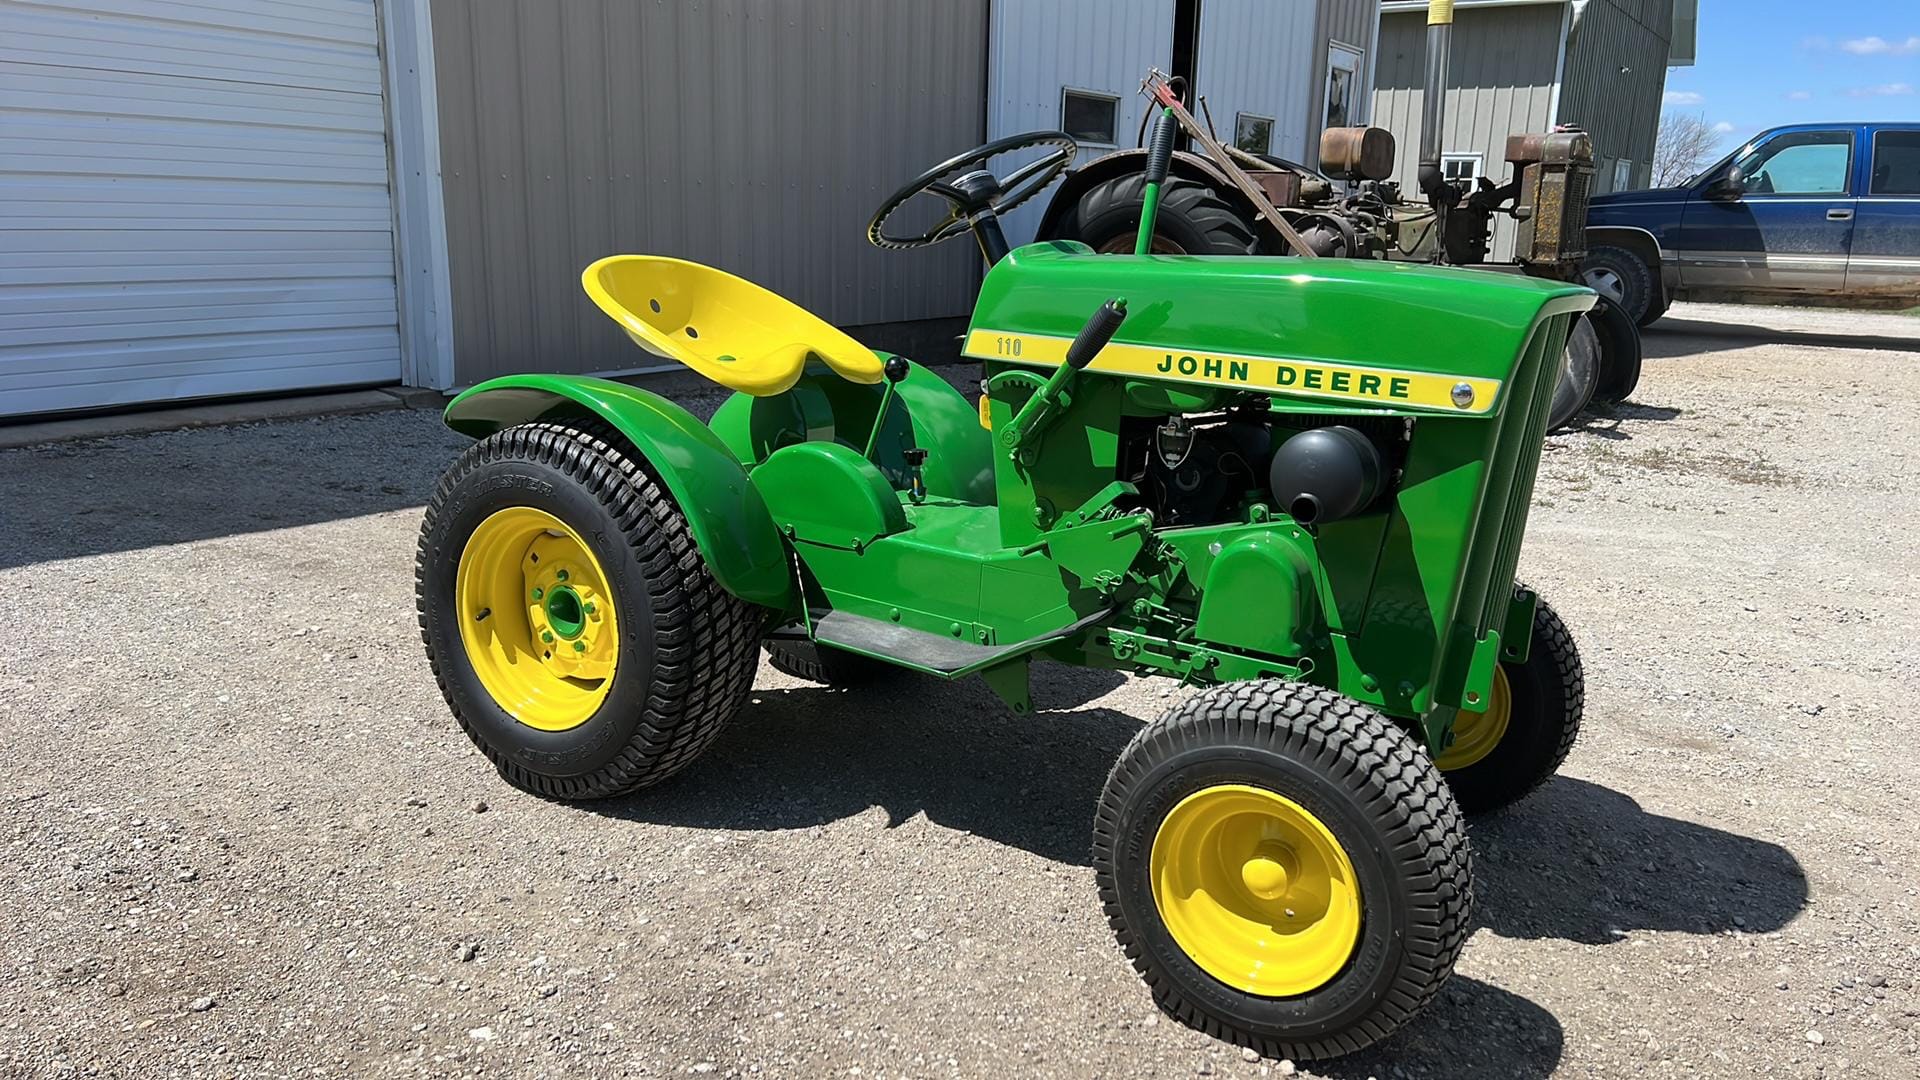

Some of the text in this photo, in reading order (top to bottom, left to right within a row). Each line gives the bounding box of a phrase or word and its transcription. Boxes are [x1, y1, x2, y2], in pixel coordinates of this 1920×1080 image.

[997, 337, 1022, 356] 110
[1157, 355, 1410, 398] JOHN DEERE
[473, 474, 553, 498] MASTER
